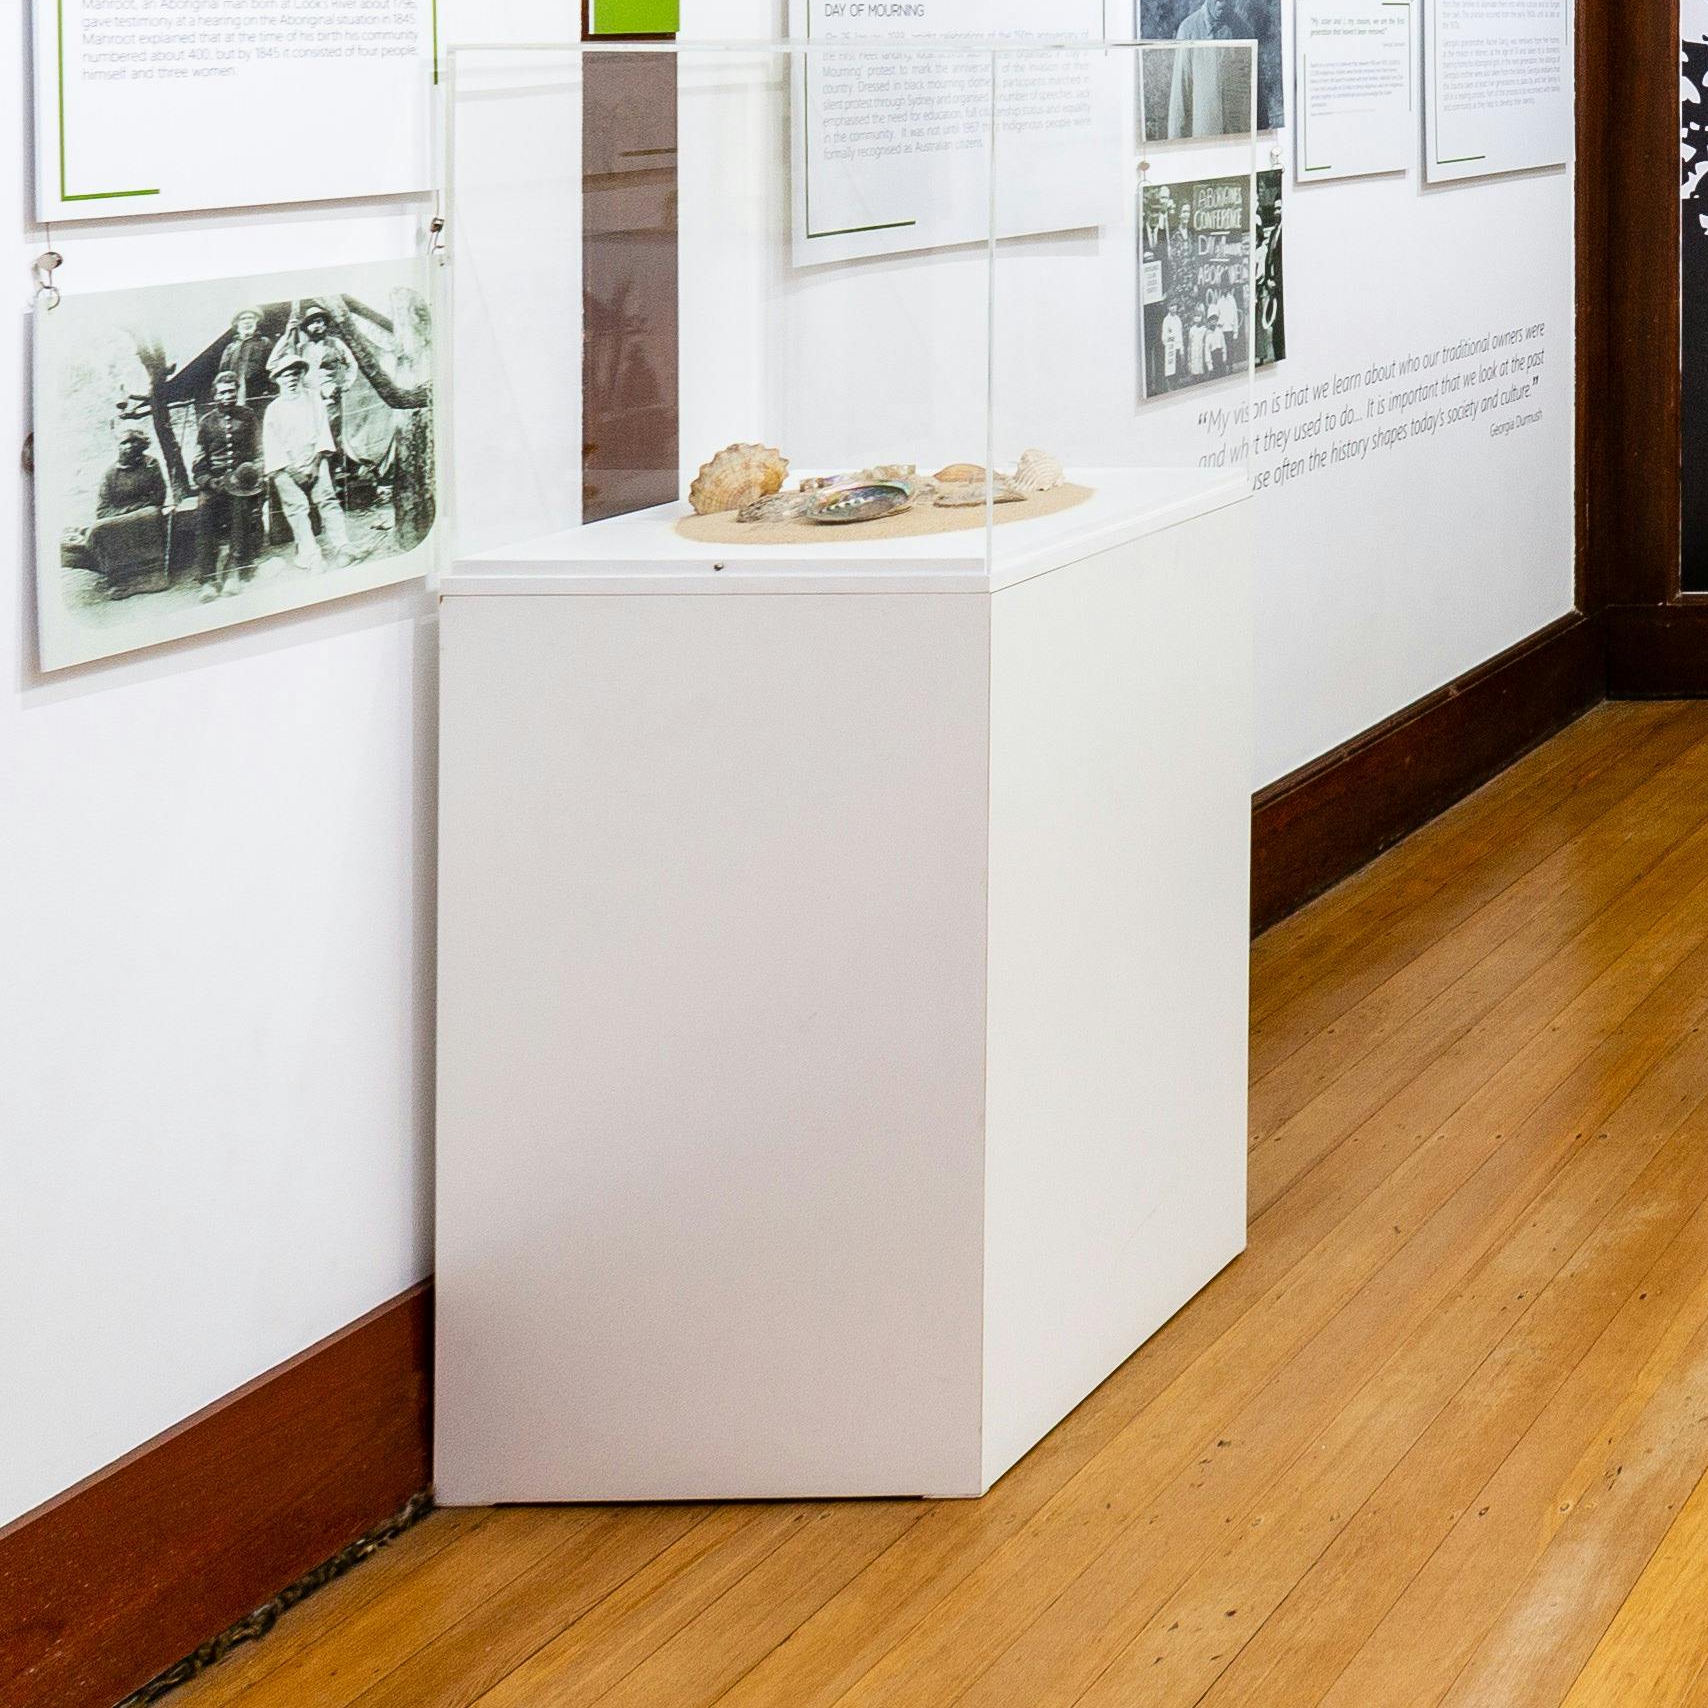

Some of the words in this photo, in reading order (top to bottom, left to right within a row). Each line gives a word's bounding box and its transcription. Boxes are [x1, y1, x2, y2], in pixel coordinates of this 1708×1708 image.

[824, 3, 847, 18] DAY
[849, 3, 865, 18] OF
[868, 3, 926, 18] MOURNING
[1263, 425, 1291, 454] they
[1293, 412, 1323, 442] used
[1324, 412, 1337, 433] to
[1388, 380, 1439, 415] important
[1440, 372, 1462, 396] that
[1478, 359, 1499, 384] look
[1284, 384, 1310, 411] that
[1312, 380, 1329, 401] we
[1332, 372, 1362, 397] learn
[1364, 359, 1397, 386] about
[1398, 352, 1421, 376] who
[1422, 349, 1441, 370] our
[1441, 331, 1491, 364] traditional
[1491, 325, 1524, 352] owners
[1525, 322, 1546, 341] were
